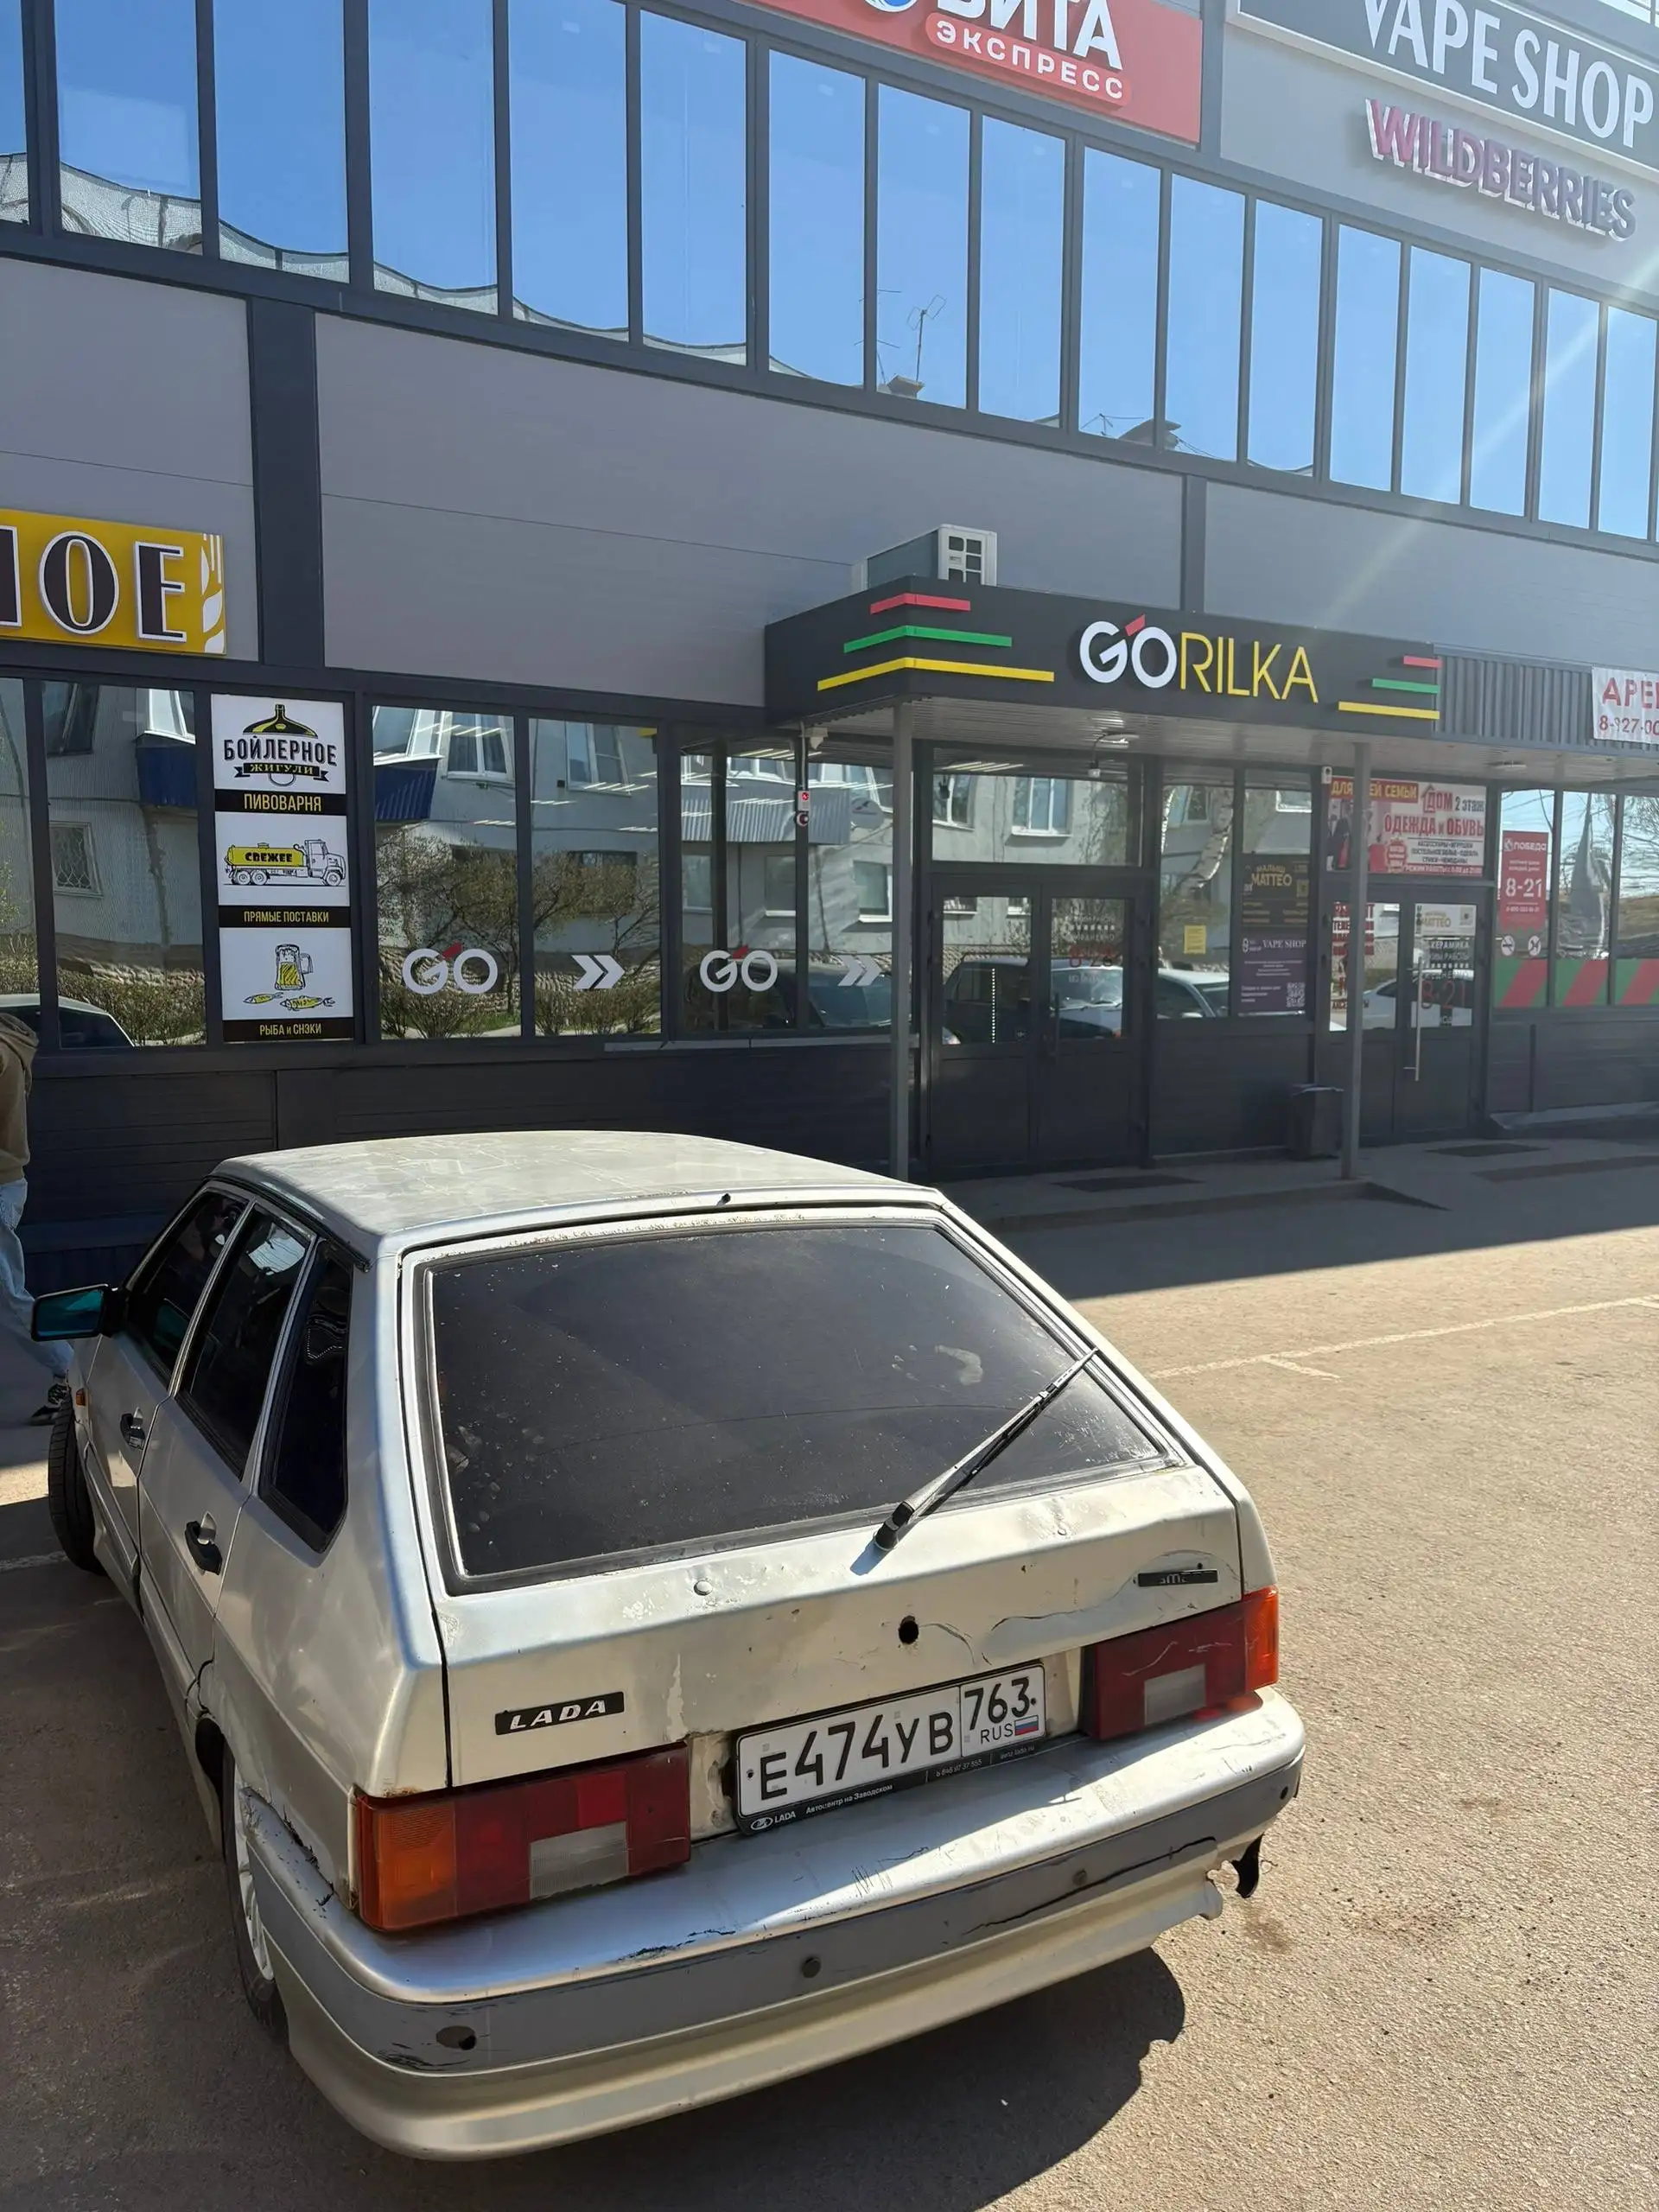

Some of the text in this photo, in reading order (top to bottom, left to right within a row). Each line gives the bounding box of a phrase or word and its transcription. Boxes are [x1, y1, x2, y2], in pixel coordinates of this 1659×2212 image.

[936, 20, 1123, 100] ЭКСПРЕСС
[1363, 0, 1654, 149] VAPE SHOP
[1364, 99, 1637, 243] WILDBERRIES
[1079, 614, 1319, 703] GORILKA
[224, 735, 338, 766] БОЙЛЕРНОЕ
[250, 764, 314, 775] ЖИГУЛИ
[1331, 782, 1354, 796] ДЛЯ
[1385, 785, 1417, 798] СЕМЬИ
[1423, 789, 1453, 813] ДОМ
[1455, 797, 1460, 810] 2
[244, 793, 321, 812] ПИВОВАРНЯ
[1384, 814, 1436, 836] ОДЕЖДА
[1446, 817, 1484, 837] ОБУВЬ
[245, 851, 293, 862] СВЕЖЕЕ
[1251, 873, 1293, 887] MATTEO
[1505, 877, 1542, 898] 8-21
[244, 911, 329, 923] ПРЯМЫЕ ПОСТАВКИ
[1262, 939, 1284, 948] VAPE
[1285, 939, 1306, 948] SHOP
[402, 942, 499, 995] GO
[700, 945, 778, 992] GO
[260, 1024, 285, 1036] РЫБА
[293, 1023, 322, 1034] СНЭКИ
[510, 1700, 607, 1731] LADA
[964, 1677, 1031, 1731] 763
[981, 1723, 1014, 1745] RUS
[806, 1784, 893, 1815] Автоцентр на Заводском
[774, 1810, 797, 1823] LADA
